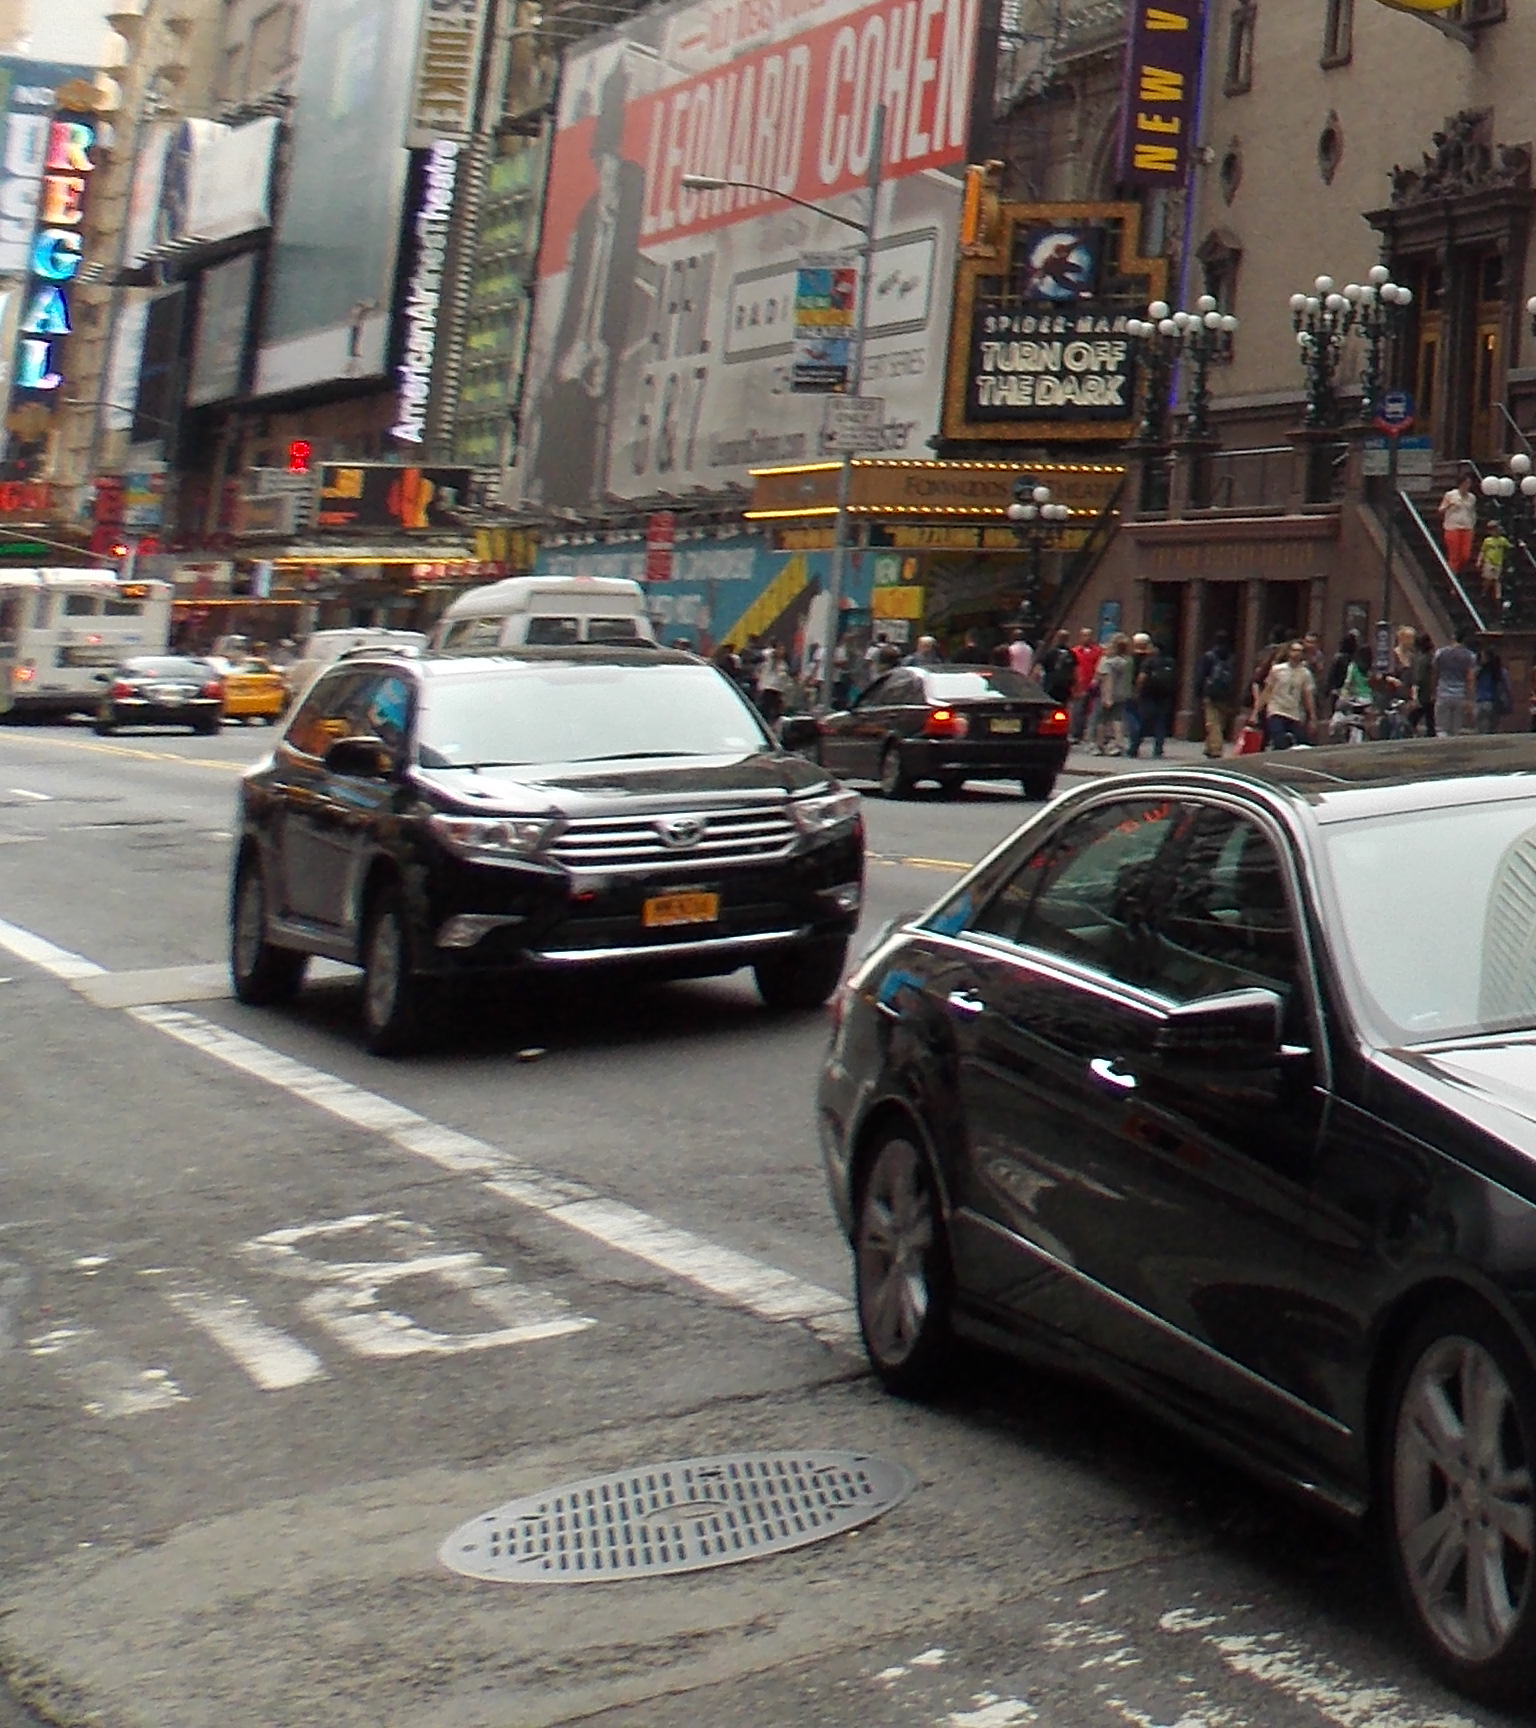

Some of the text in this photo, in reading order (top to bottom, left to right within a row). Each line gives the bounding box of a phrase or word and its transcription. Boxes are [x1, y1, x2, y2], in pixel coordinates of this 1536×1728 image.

[641, 43, 812, 236] LEONARD
[1134, 66, 1185, 171] NEW
[14, 122, 95, 391] REGAL
[976, 374, 1127, 407] THE DARK
[980, 340, 1127, 373] TURN OFF
